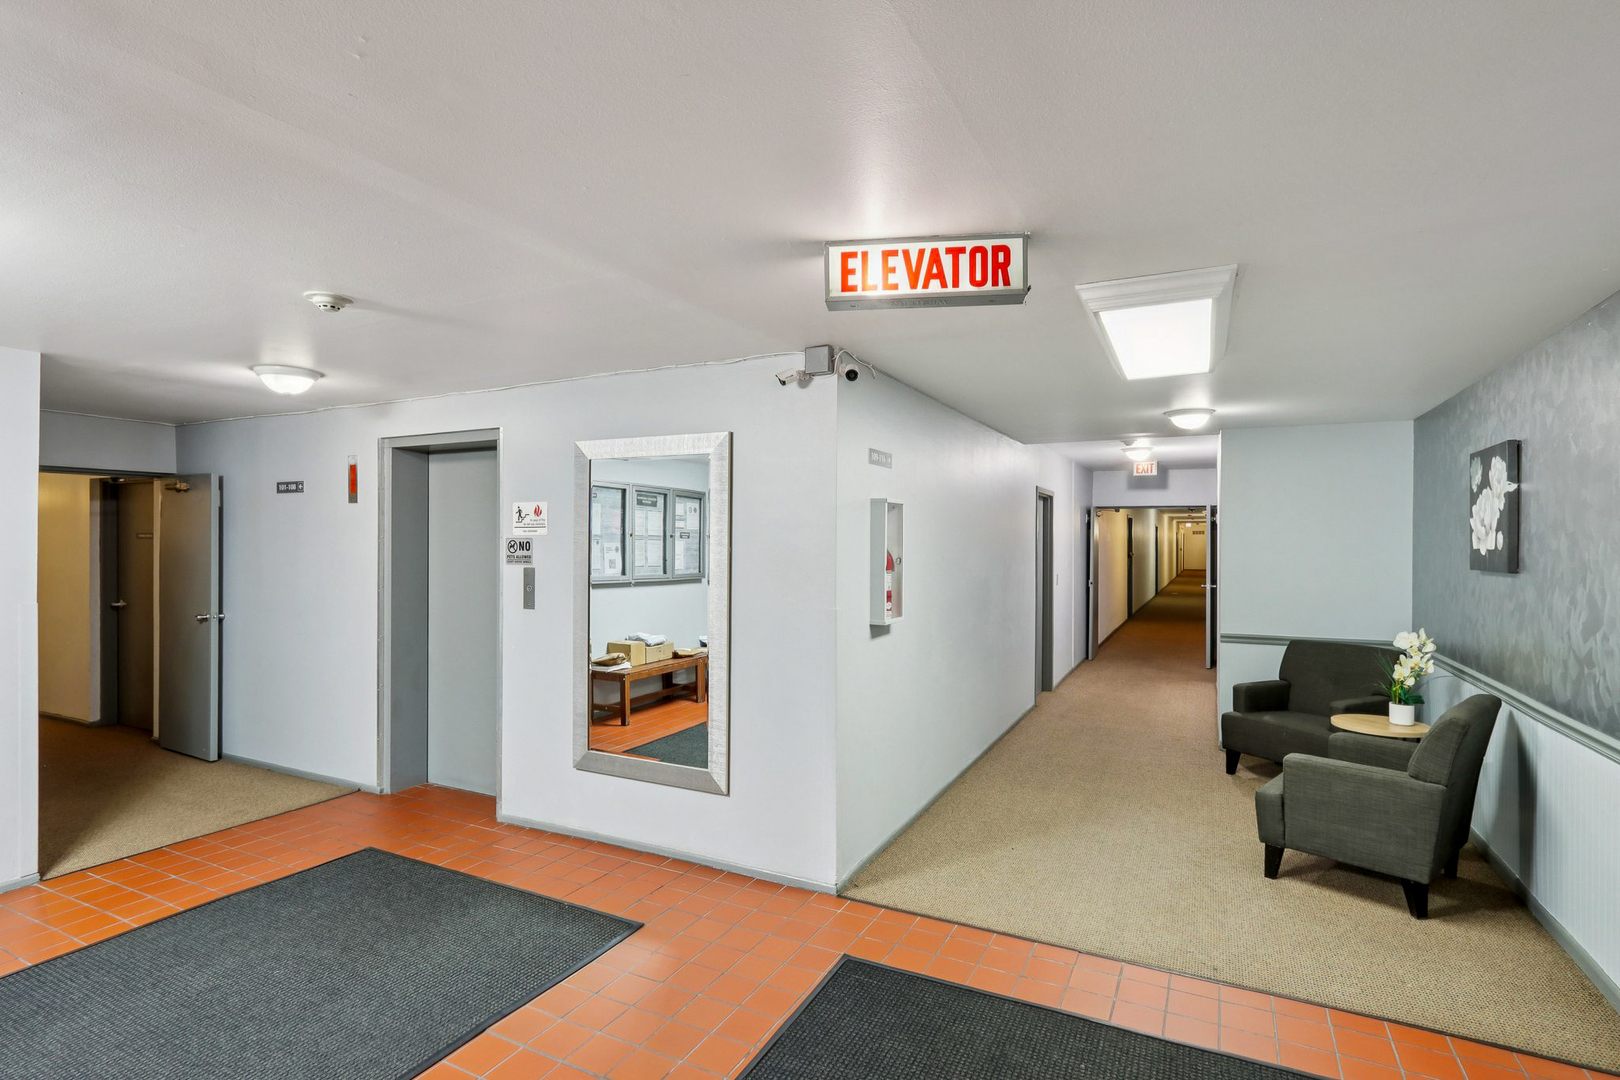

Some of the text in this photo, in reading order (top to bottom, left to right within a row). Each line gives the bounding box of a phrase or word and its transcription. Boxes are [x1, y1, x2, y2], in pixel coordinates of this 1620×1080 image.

[840, 244, 1012, 293] ELEVATOR
[1135, 462, 1155, 474] EXIT
[518, 540, 531, 551] NO
